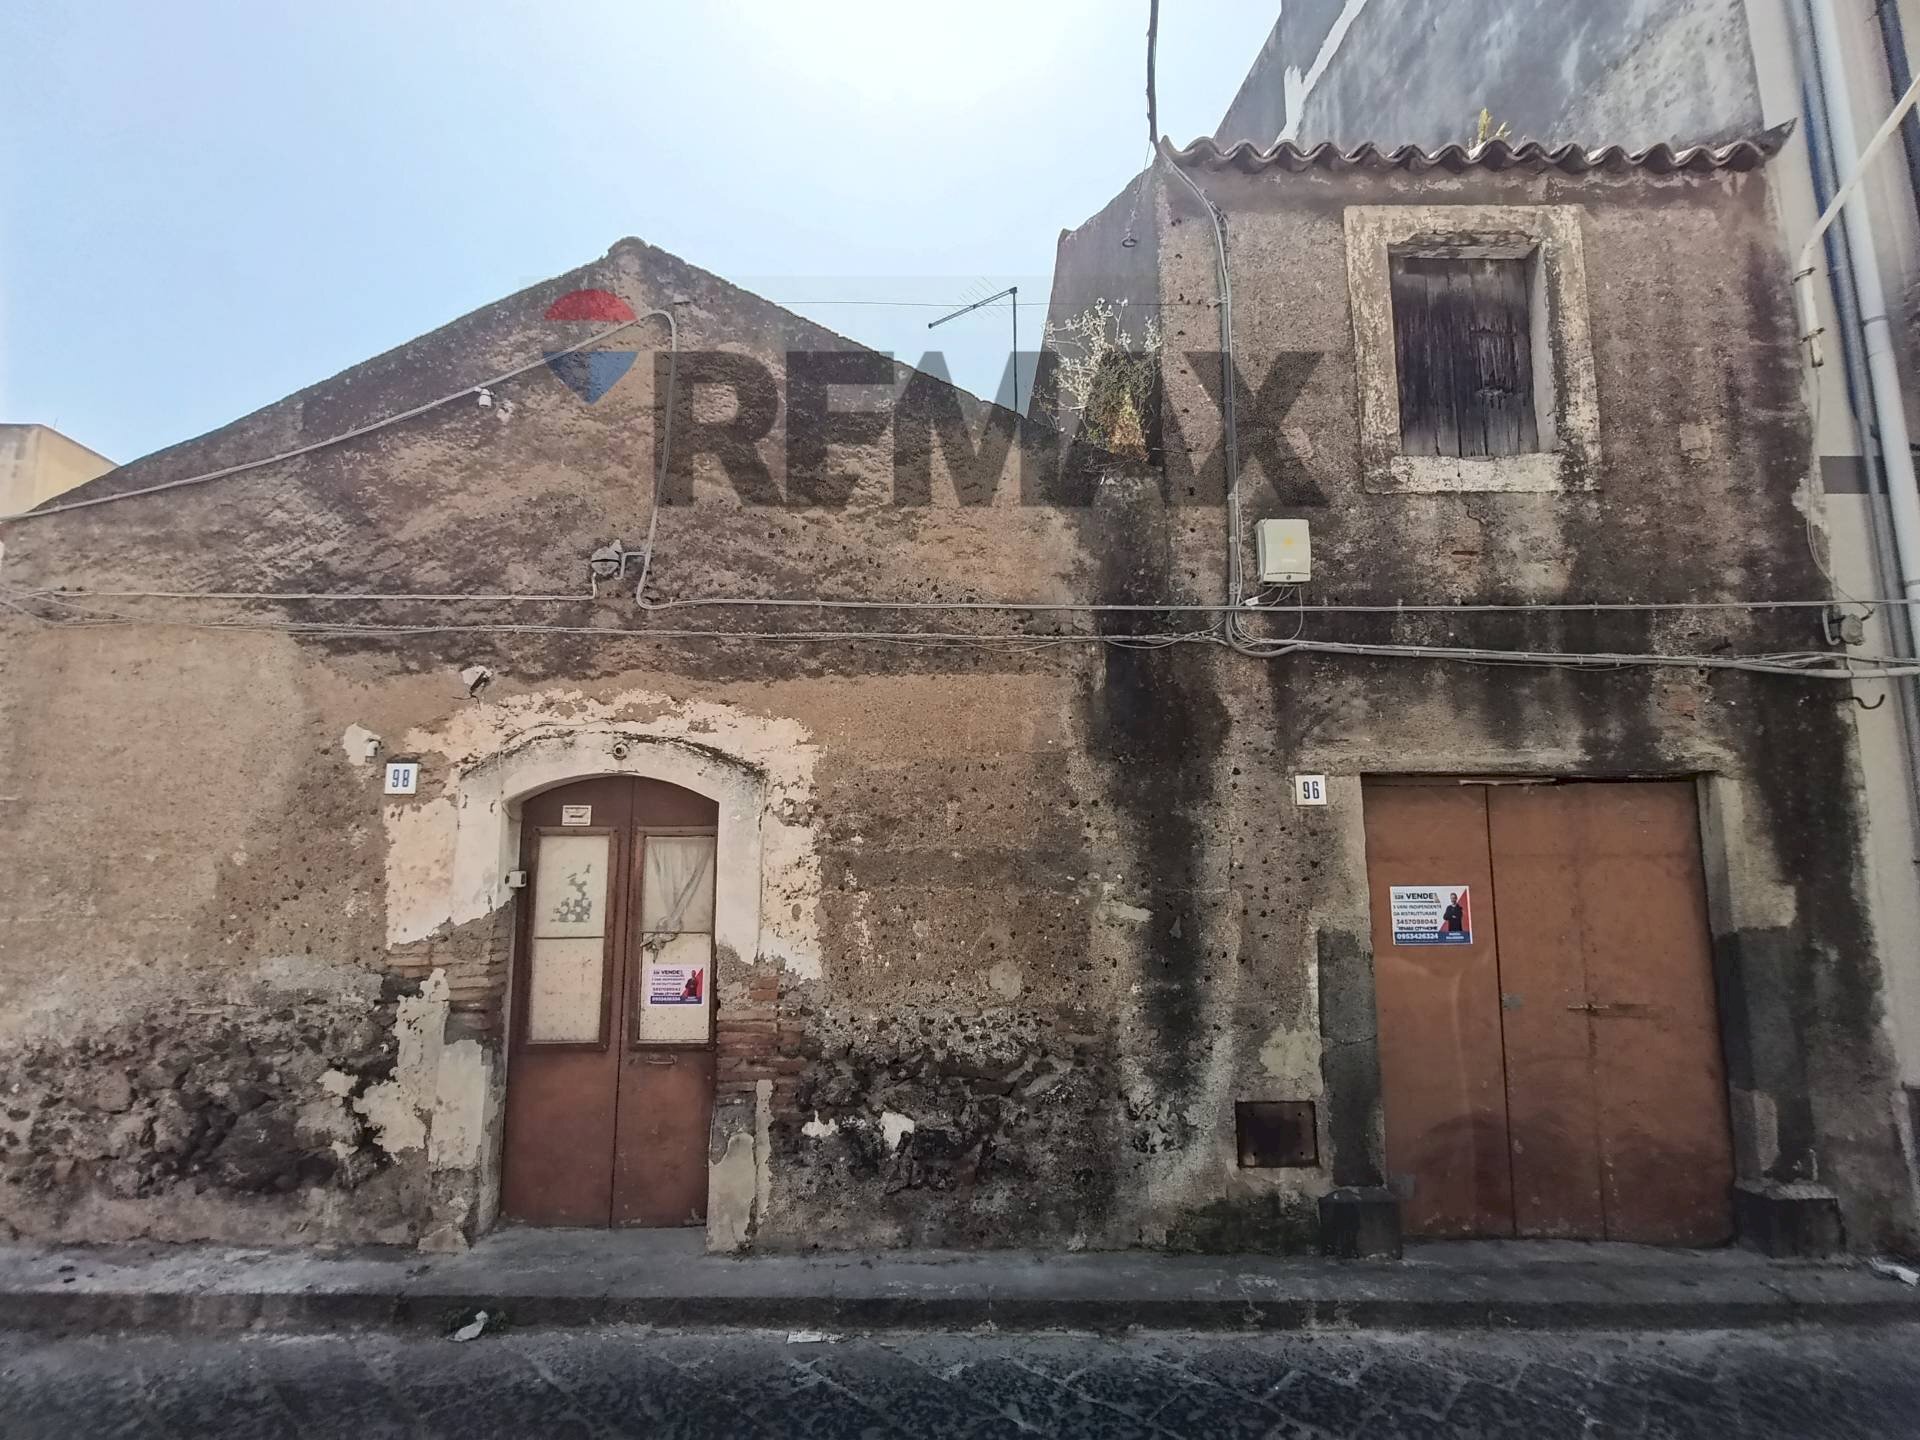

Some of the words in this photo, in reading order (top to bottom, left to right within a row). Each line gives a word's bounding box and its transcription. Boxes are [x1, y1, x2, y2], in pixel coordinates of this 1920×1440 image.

[392, 769, 410, 787] 98
[1303, 781, 1320, 799] 96
[1405, 892, 1434, 900] VENDE
